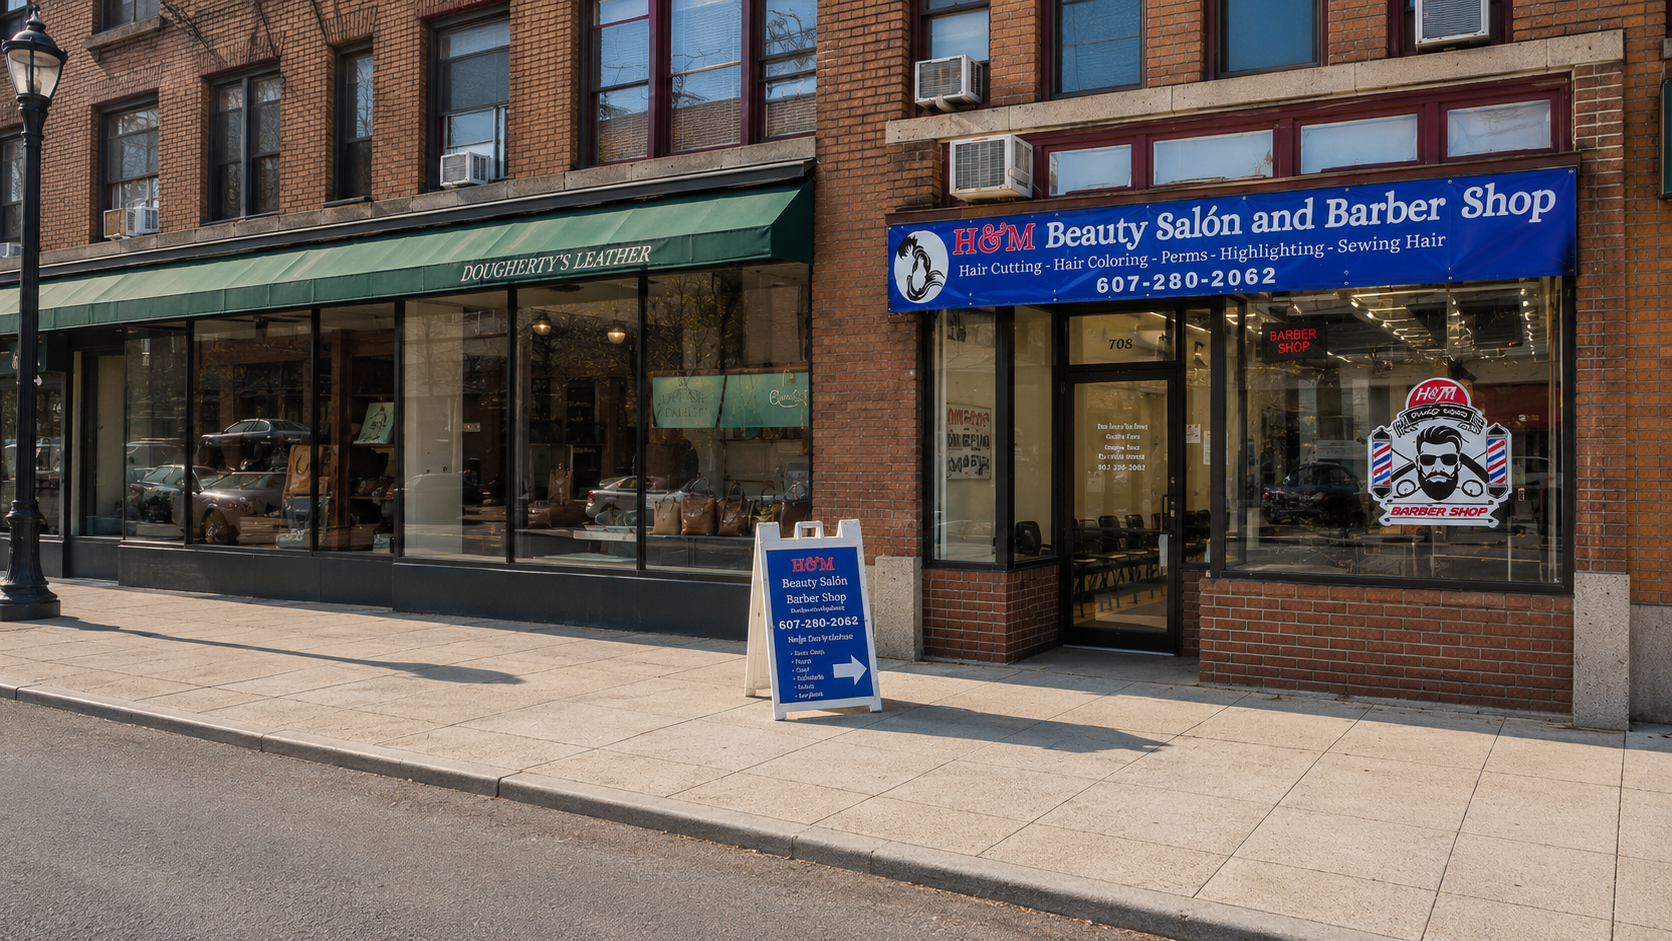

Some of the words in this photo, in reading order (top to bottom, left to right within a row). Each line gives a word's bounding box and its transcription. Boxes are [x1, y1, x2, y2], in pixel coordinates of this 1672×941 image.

[953, 222, 1035, 255] H&M
[1046, 218, 1148, 250] Beauty
[1157, 205, 1242, 240] Salón
[1252, 197, 1315, 233] and
[1325, 190, 1446, 228] Barber
[1462, 182, 1556, 223] Shop
[960, 264, 987, 276] Hair
[991, 260, 1042, 275] Cutting
[1054, 257, 1084, 270] Hair
[1088, 254, 1148, 269] Coloring
[1161, 251, 1207, 264] Perms
[1220, 242, 1324, 262] Highlighting
[1338, 237, 1400, 253] Sewing
[1406, 233, 1446, 248] Hair
[460, 253, 571, 282] DOUGHERTY'S
[573, 245, 651, 269] LEATHER
[1096, 267, 1276, 293] 607-280-2062
[1270, 328, 1317, 342] BARBER
[1109, 339, 1132, 349] 708
[1278, 341, 1310, 354] SHOP
[1415, 386, 1457, 402] H&M
[1391, 507, 1446, 516] BARBER
[1449, 508, 1488, 516] SHOP
[791, 556, 835, 573] H&M
[782, 579, 818, 590] Beauty
[787, 593, 819, 605] Barber
[822, 592, 847, 605] Shop
[779, 616, 859, 630] 607-280-2062
